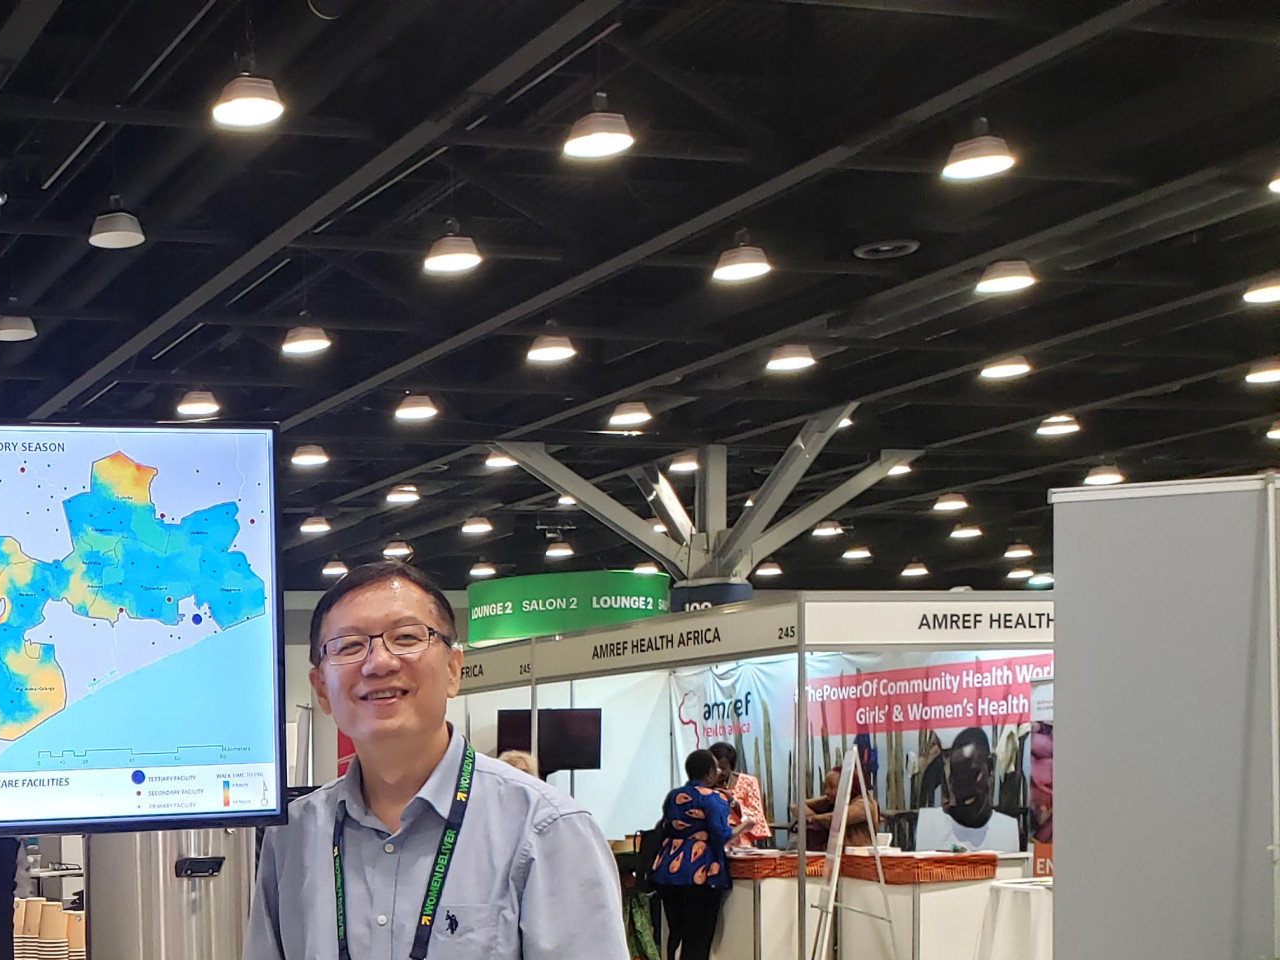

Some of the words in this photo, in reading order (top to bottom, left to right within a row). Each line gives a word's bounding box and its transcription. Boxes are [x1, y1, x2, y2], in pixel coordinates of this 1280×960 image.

[21, 442, 65, 452] SEASON
[471, 602, 503, 620] LOUNGE
[504, 601, 513, 614] 2
[522, 599, 566, 612] SALON
[569, 597, 578, 610] 2
[592, 596, 645, 609] LOUNGE
[646, 597, 654, 610] 2
[778, 625, 795, 640] 245
[918, 613, 982, 630] AMREF
[592, 641, 628, 660] AMREF
[631, 634, 674, 655] HEALTH
[677, 627, 721, 649] AFRICA
[460, 664, 484, 680] FRICA
[519, 664, 531, 675] 245
[880, 672, 960, 694] Community
[962, 665, 1013, 689] Health
[703, 691, 751, 721] amref
[856, 704, 889, 725] Girls'
[892, 704, 904, 722] &
[907, 698, 974, 721] Women's
[977, 693, 1029, 716] Health
[21, 777, 70, 788] FACILITIES
[458, 757, 474, 792] WOMEN
[422, 872, 445, 915] WOMEN
[435, 828, 456, 873] DELIVER
